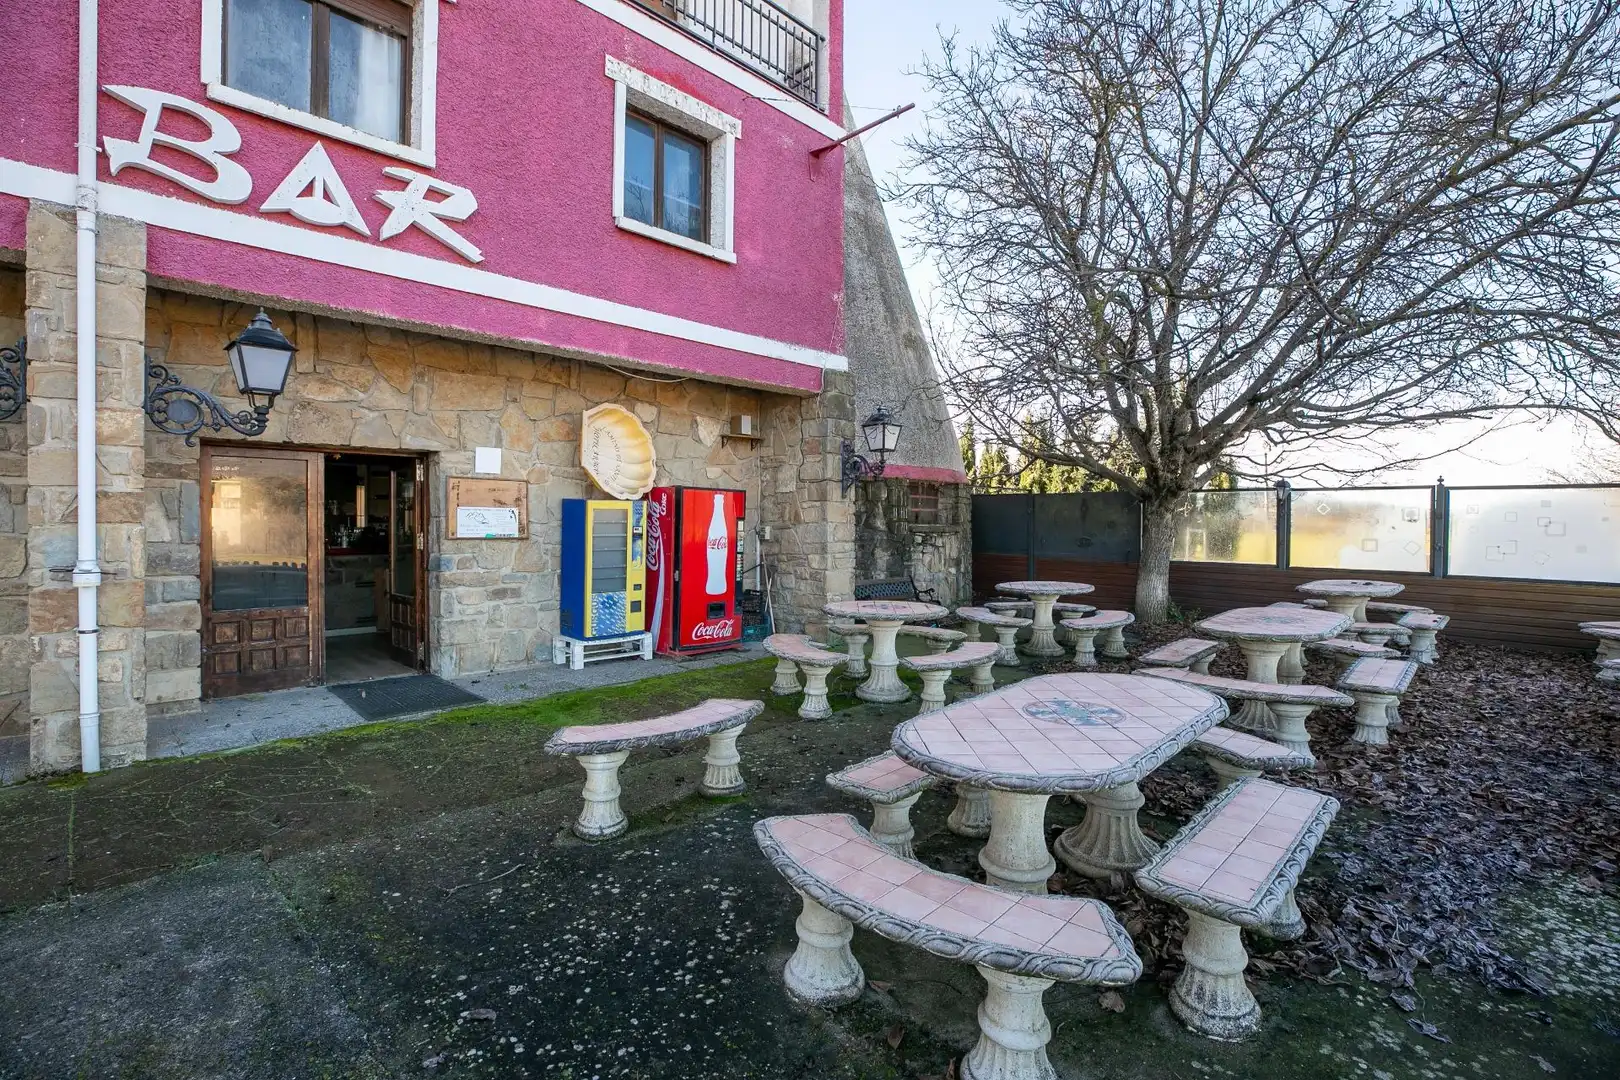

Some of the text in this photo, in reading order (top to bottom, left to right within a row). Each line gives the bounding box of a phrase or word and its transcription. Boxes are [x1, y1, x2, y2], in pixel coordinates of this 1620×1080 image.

[101, 84, 485, 262] BAR
[647, 495, 660, 571] Coca-Cola
[692, 619, 735, 640] Coca-Cola
